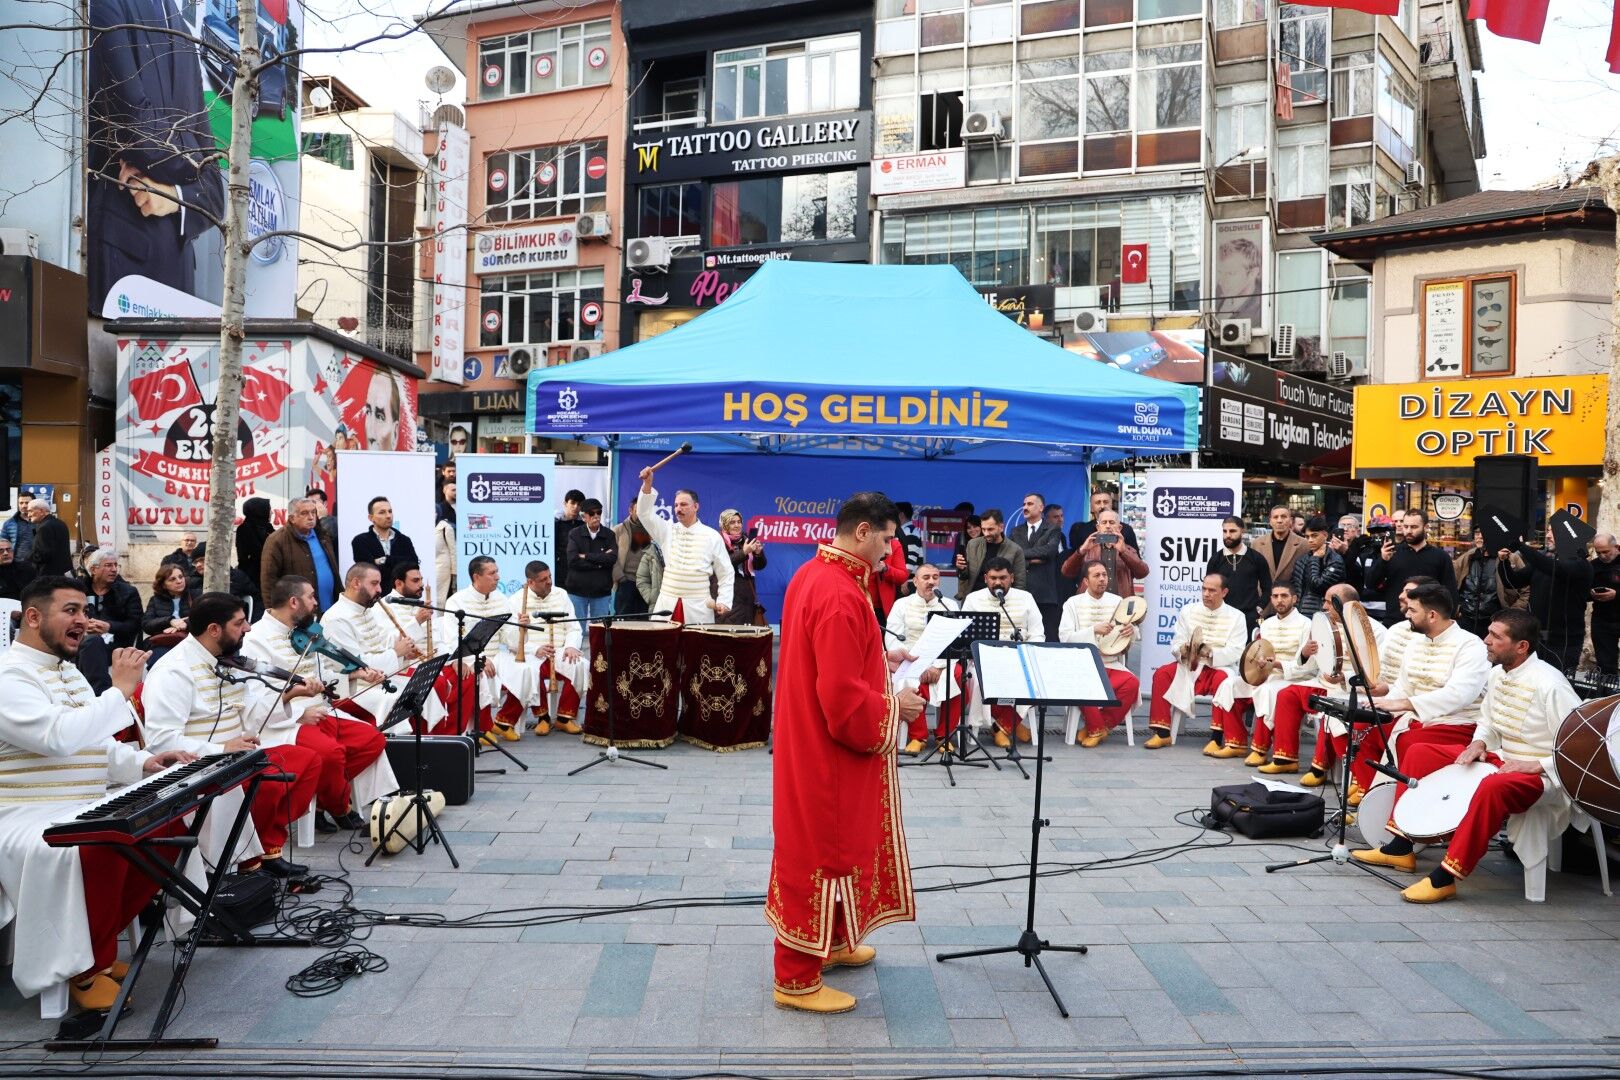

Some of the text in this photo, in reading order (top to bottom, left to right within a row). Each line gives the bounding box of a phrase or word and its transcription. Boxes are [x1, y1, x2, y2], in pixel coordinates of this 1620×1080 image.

[667, 129, 751, 157] TATTOO
[757, 119, 860, 148] GALLERY
[732, 150, 857, 172] TATTOO PIERCING
[897, 155, 946, 170] ERMAN
[1219, 224, 1256, 232] GOLDWELL
[494, 232, 556, 251] BİLİMKUR
[528, 250, 567, 263] KURSU
[434, 272, 443, 368] KURSU
[1278, 378, 1304, 404] Touch
[1307, 387, 1326, 408] Your
[1399, 386, 1572, 419] DİZAYN
[723, 390, 1008, 428] HOŞ GELDİNİZ
[1268, 412, 1310, 449] Tuğkan
[1416, 421, 1553, 456] OPTİK
[175, 439, 244, 460] EK
[127, 506, 204, 525] KUTLU
[503, 521, 551, 538] SİVİL
[754, 518, 836, 540] İyilik Kıla
[464, 538, 547, 556] DÜNYASI
[1160, 584, 1203, 592] KURULUŞLA
[1158, 614, 1178, 628] DA
